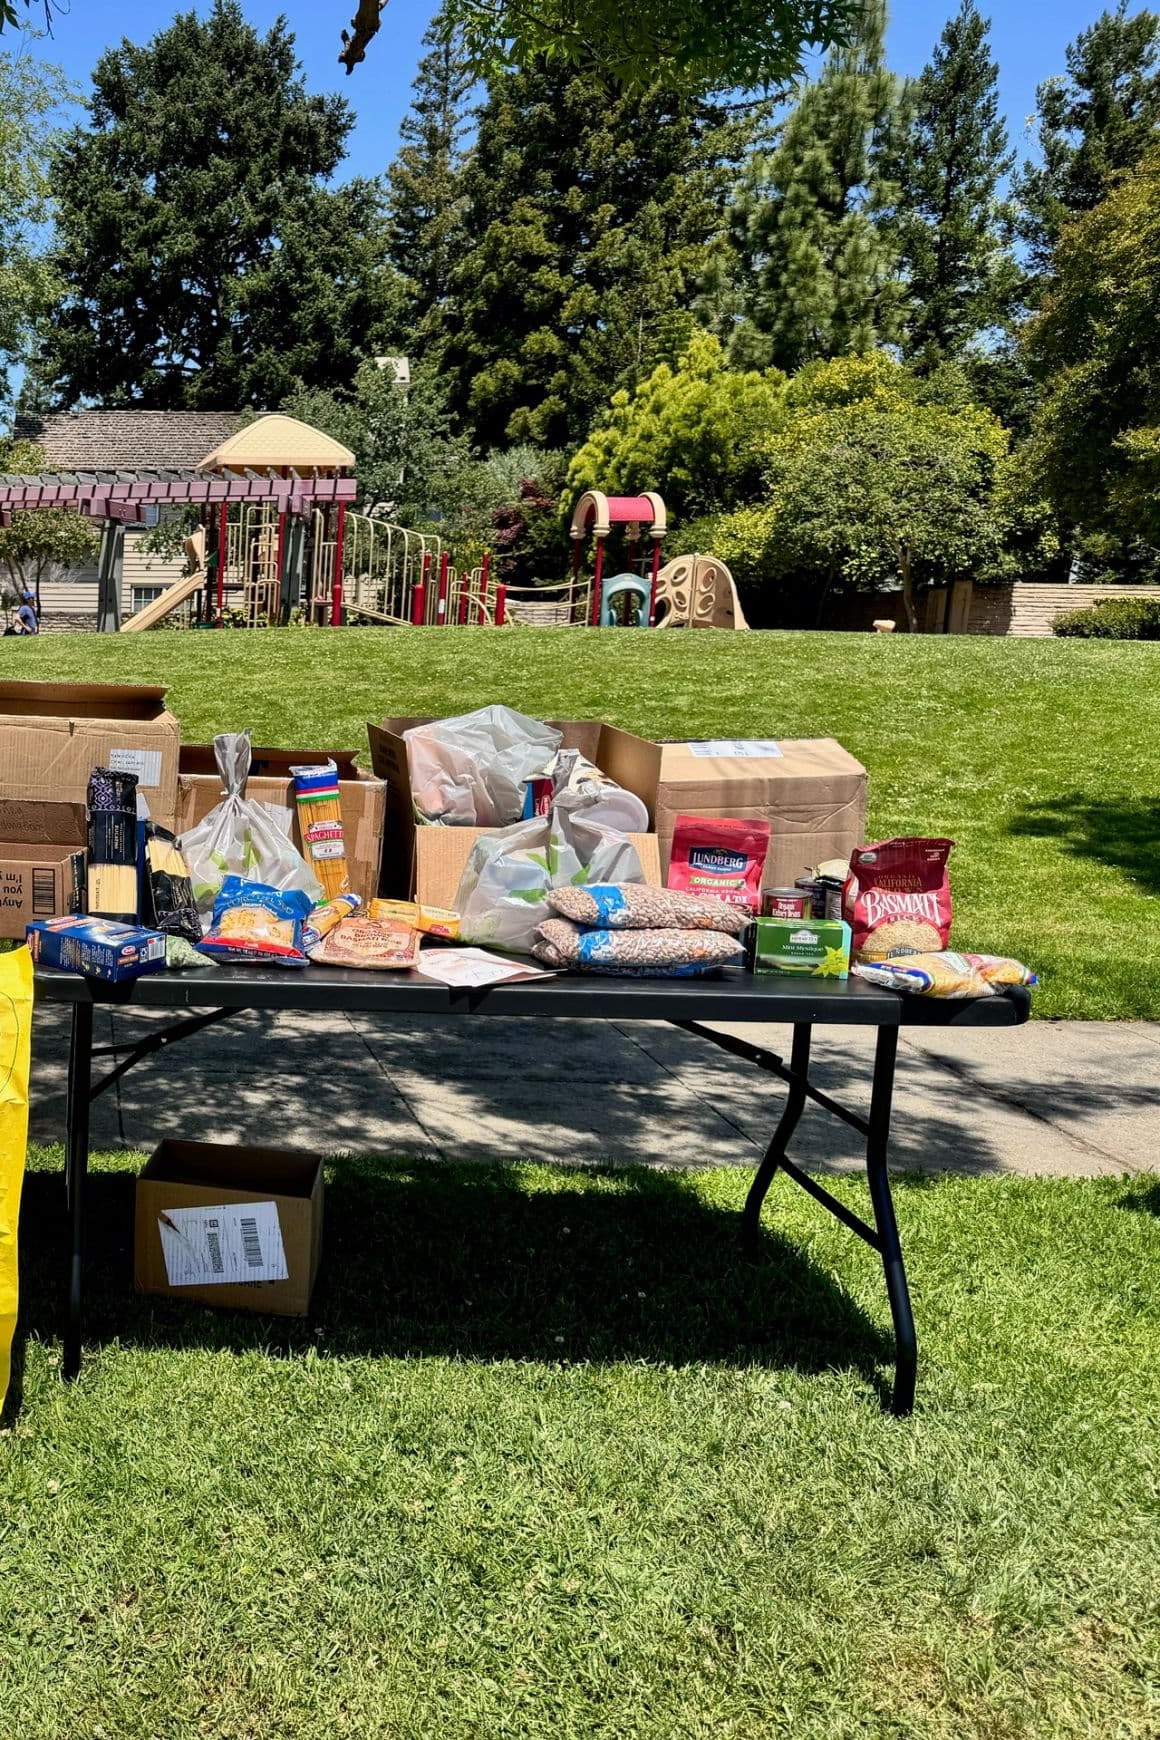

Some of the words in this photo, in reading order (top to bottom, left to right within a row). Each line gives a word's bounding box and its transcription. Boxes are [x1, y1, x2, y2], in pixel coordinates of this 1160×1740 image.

[693, 852, 743, 869] LUNDBERG
[6, 873, 22, 882] I'm
[694, 876, 738, 887] ORGANIC
[2, 884, 23, 894] you
[861, 890, 942, 928] BASMATI
